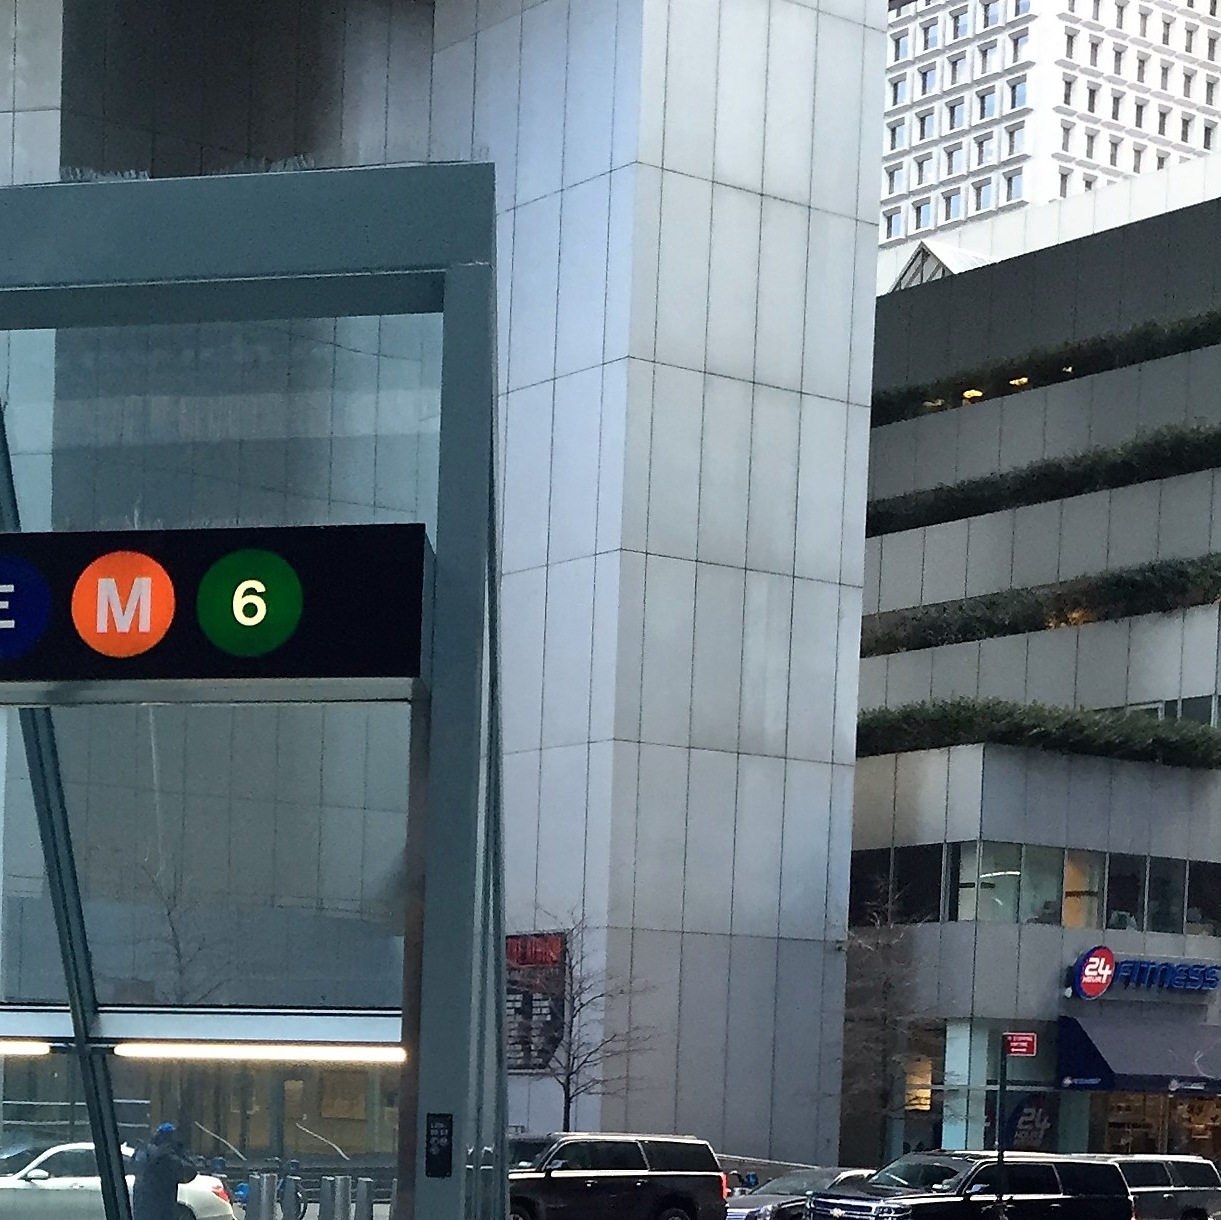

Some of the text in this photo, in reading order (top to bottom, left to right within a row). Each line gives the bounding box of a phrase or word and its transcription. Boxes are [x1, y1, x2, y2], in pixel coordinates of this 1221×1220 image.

[96, 577, 152, 633] M
[233, 579, 267, 626] 6
[1084, 957, 1113, 984] 24
